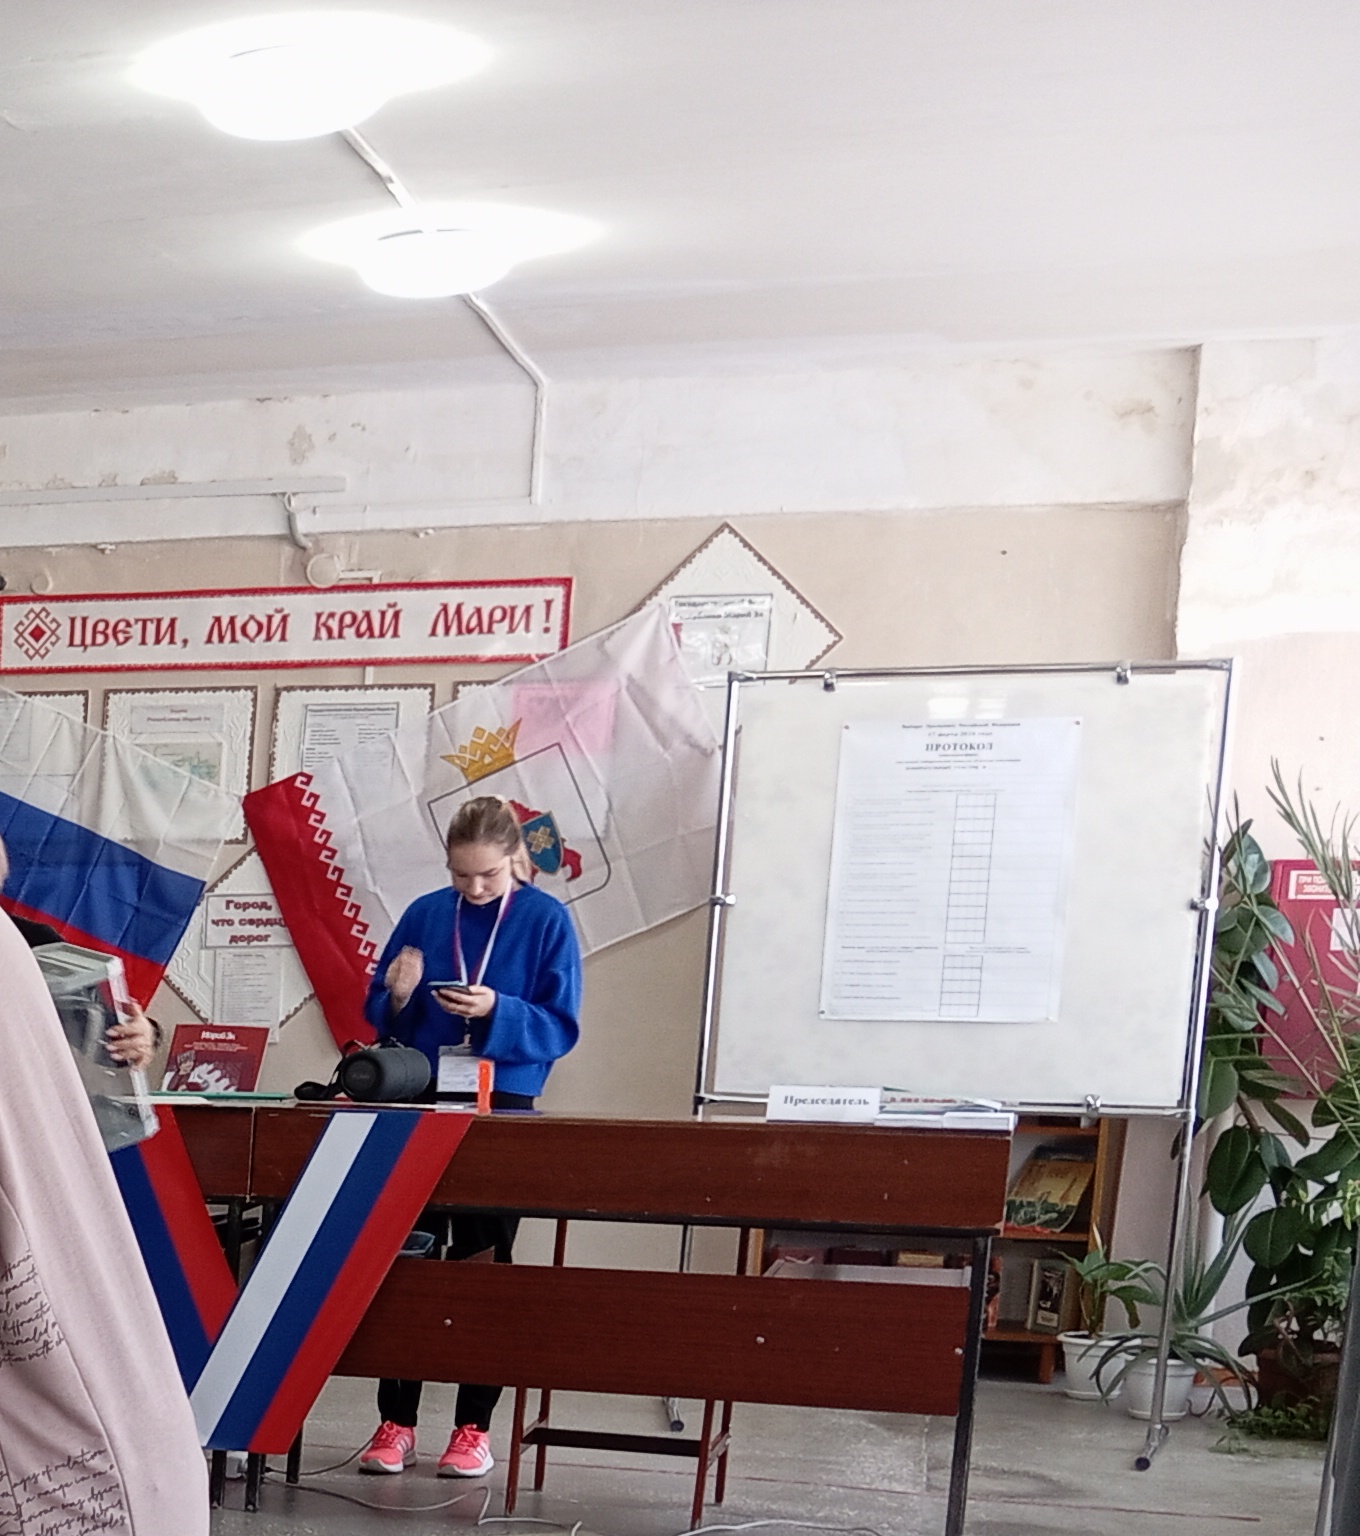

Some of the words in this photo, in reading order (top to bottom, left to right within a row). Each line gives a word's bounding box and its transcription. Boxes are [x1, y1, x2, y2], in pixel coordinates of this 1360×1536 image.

[66, 614, 189, 650] Цвети,
[204, 607, 291, 645] мой
[312, 602, 403, 642] край
[428, 598, 554, 638] Мари!
[925, 742, 994, 752] ПРОТОКОЛ
[225, 900, 273, 912] Город,
[211, 917, 234, 927] что
[228, 933, 272, 945] дорог
[783, 1094, 870, 1107] Председатель
